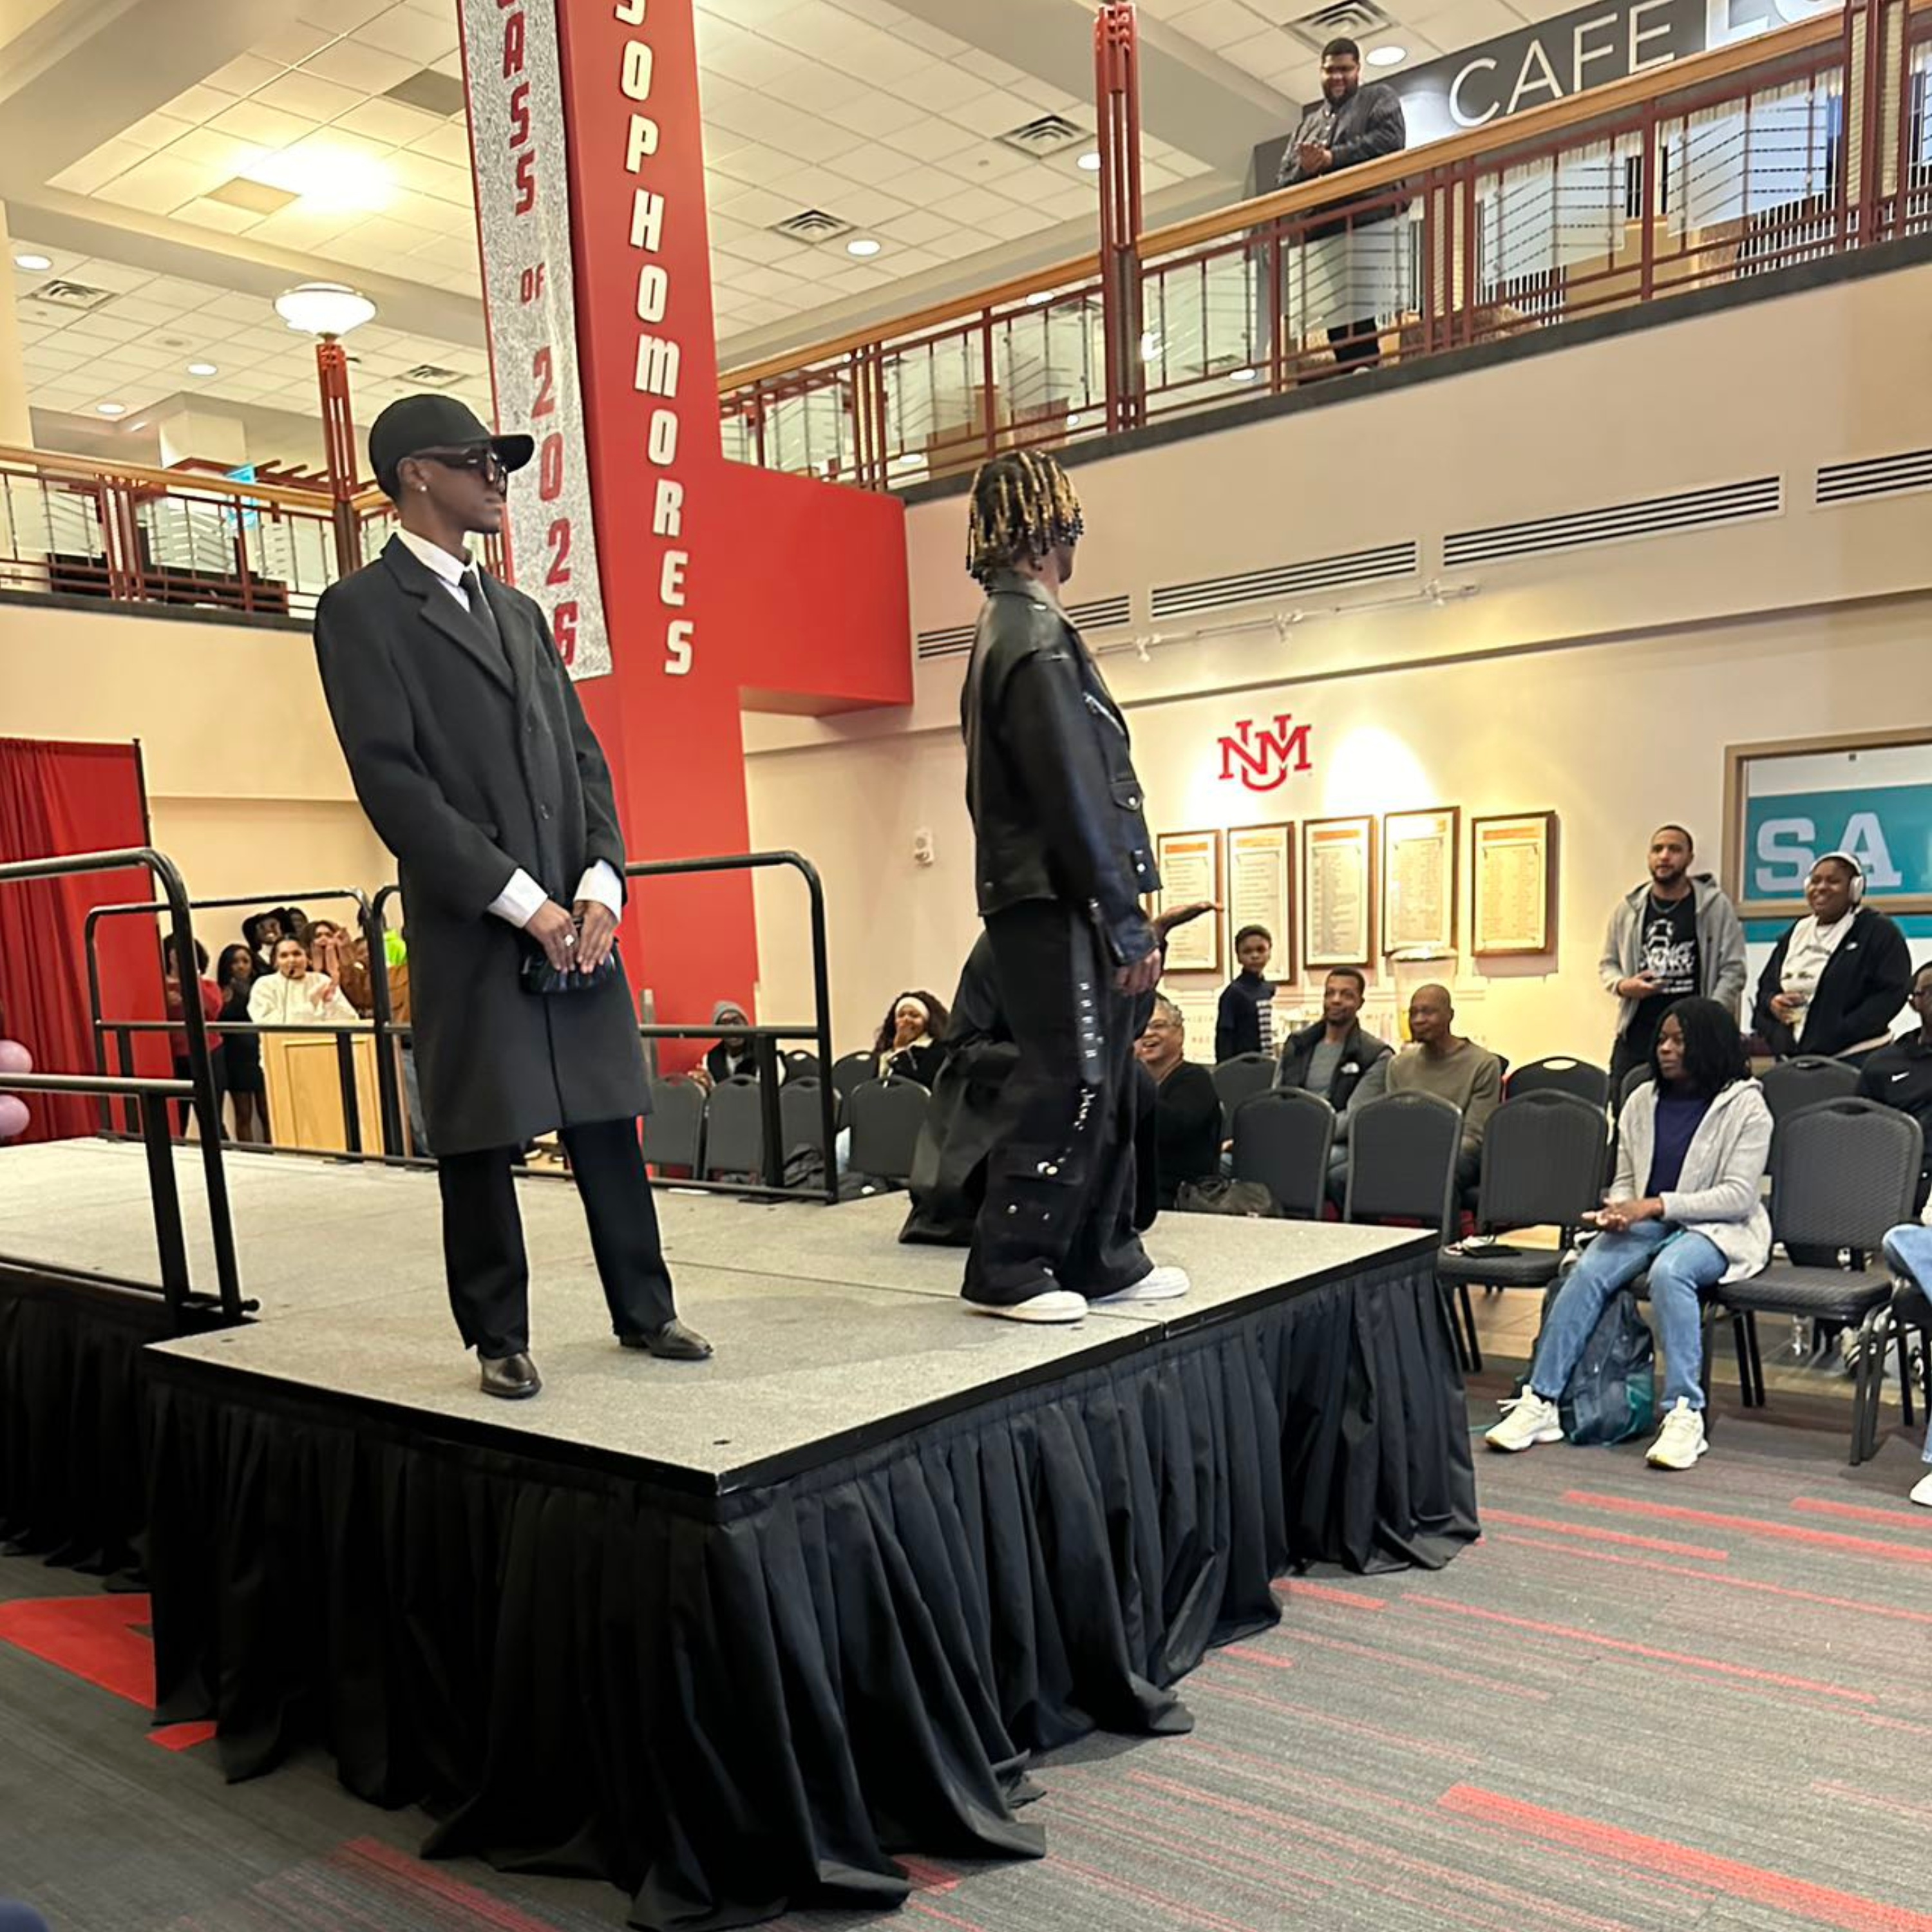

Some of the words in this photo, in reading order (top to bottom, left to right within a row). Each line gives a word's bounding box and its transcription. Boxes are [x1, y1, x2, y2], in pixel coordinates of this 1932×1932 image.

[497, 0, 535, 216] ASS
[1449, 1, 1674, 127] CAFE
[521, 263, 544, 303] OF
[531, 346, 578, 666] 2026
[1756, 812, 1932, 892] SA
